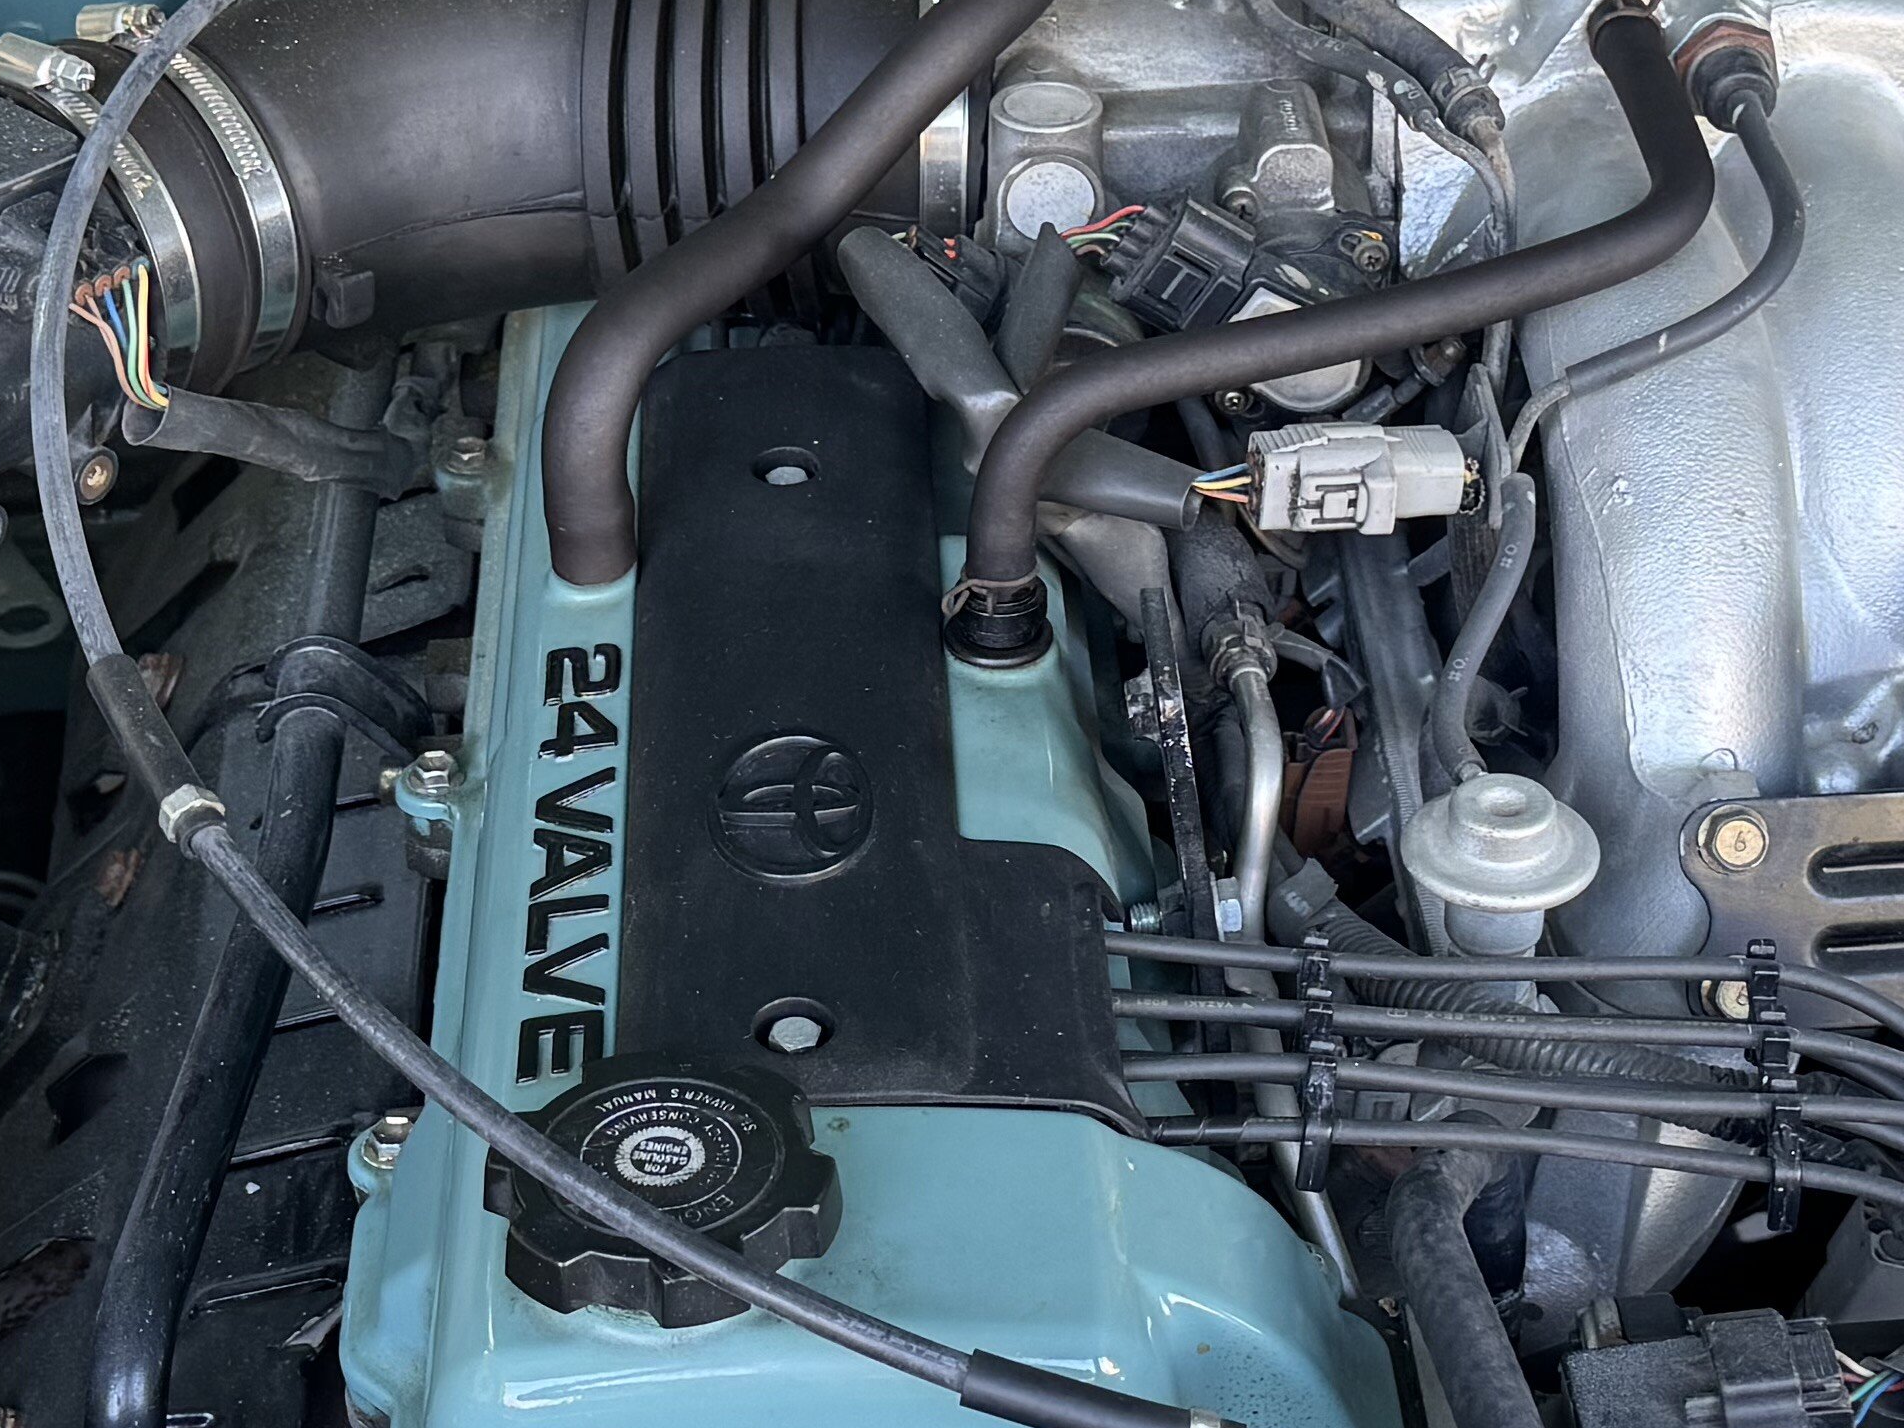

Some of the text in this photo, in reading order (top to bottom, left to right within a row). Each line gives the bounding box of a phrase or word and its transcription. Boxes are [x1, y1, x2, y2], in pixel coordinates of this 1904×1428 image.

[594, 1088, 657, 1112] MANUAL
[638, 1140, 688, 1155] ENGINES
[631, 1149, 688, 1166] GASOLINE
[643, 1164, 667, 1174] FOR
